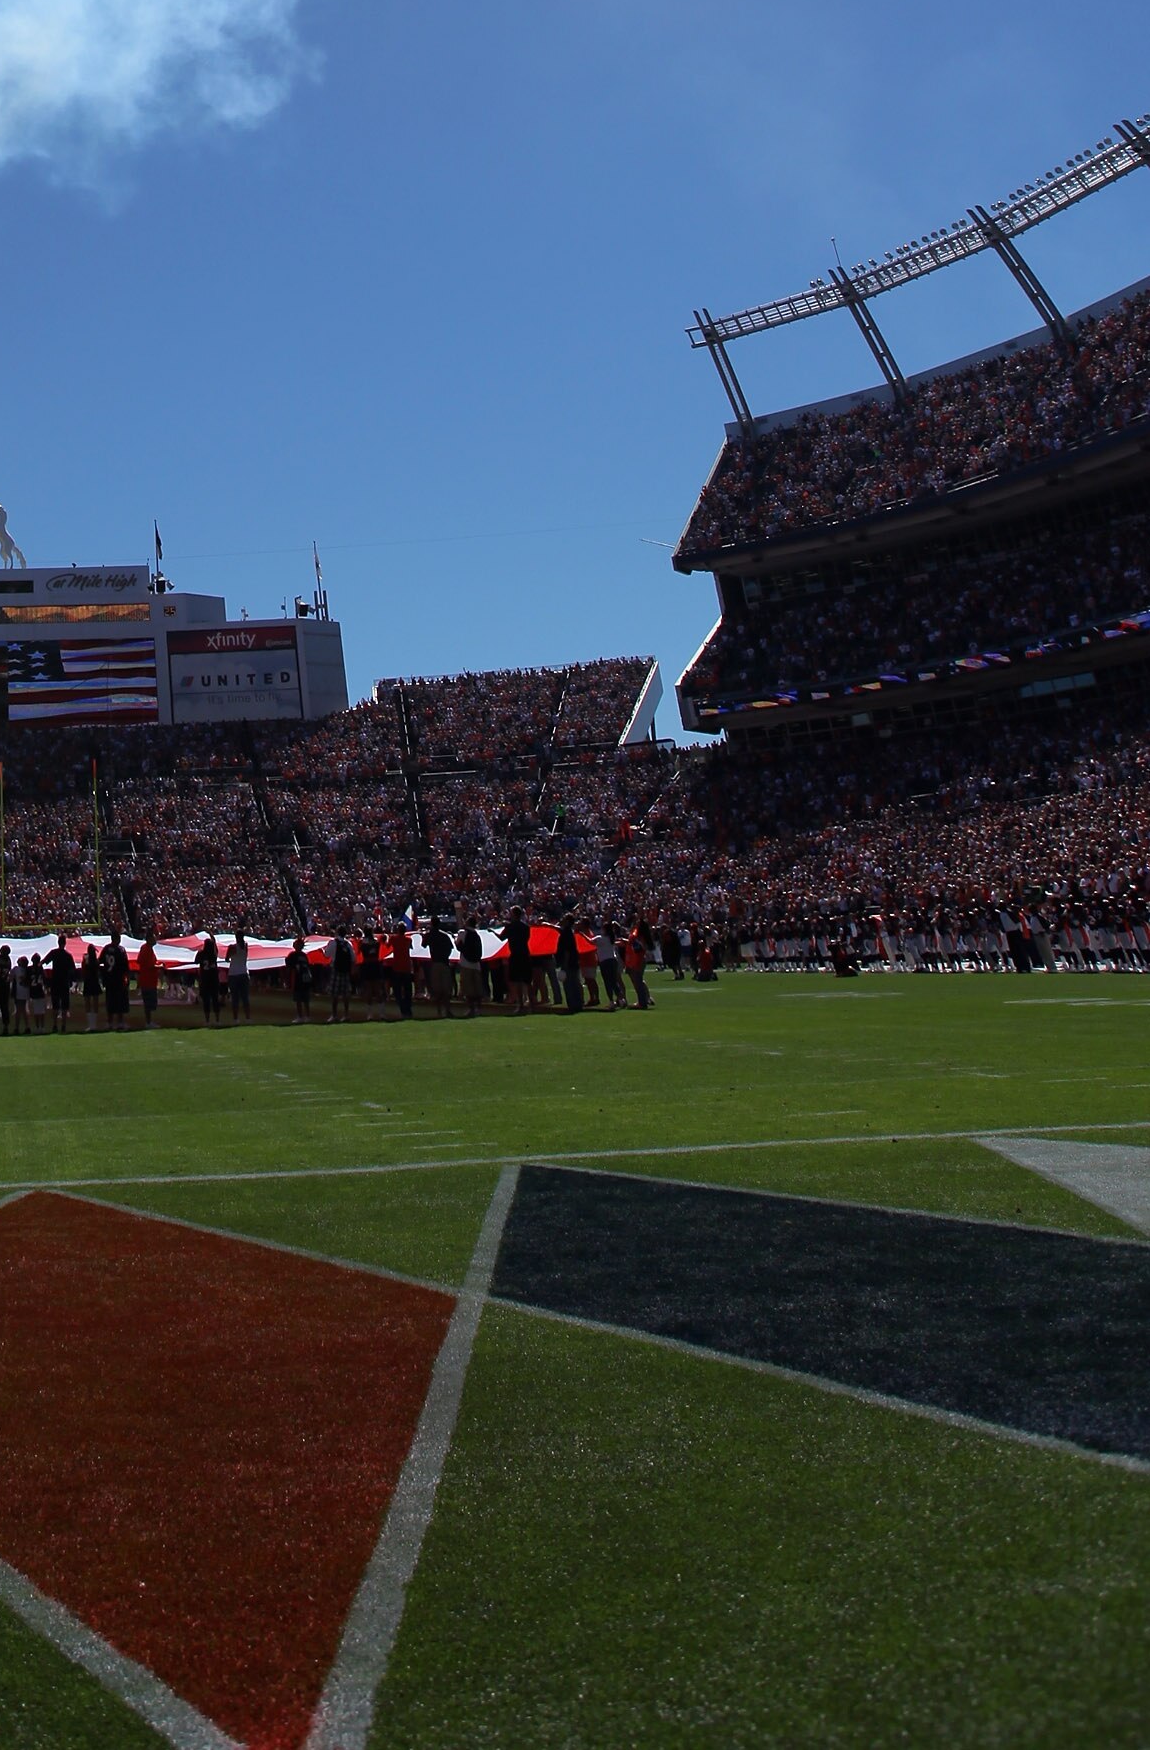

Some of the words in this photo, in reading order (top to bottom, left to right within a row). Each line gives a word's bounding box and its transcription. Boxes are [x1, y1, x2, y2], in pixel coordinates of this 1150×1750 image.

[53, 579, 66, 588] at
[61, 574, 102, 591] Mile
[104, 573, 137, 591] High
[207, 632, 256, 649] xfinity
[201, 671, 291, 687] UNITED
[254, 691, 266, 703] to
